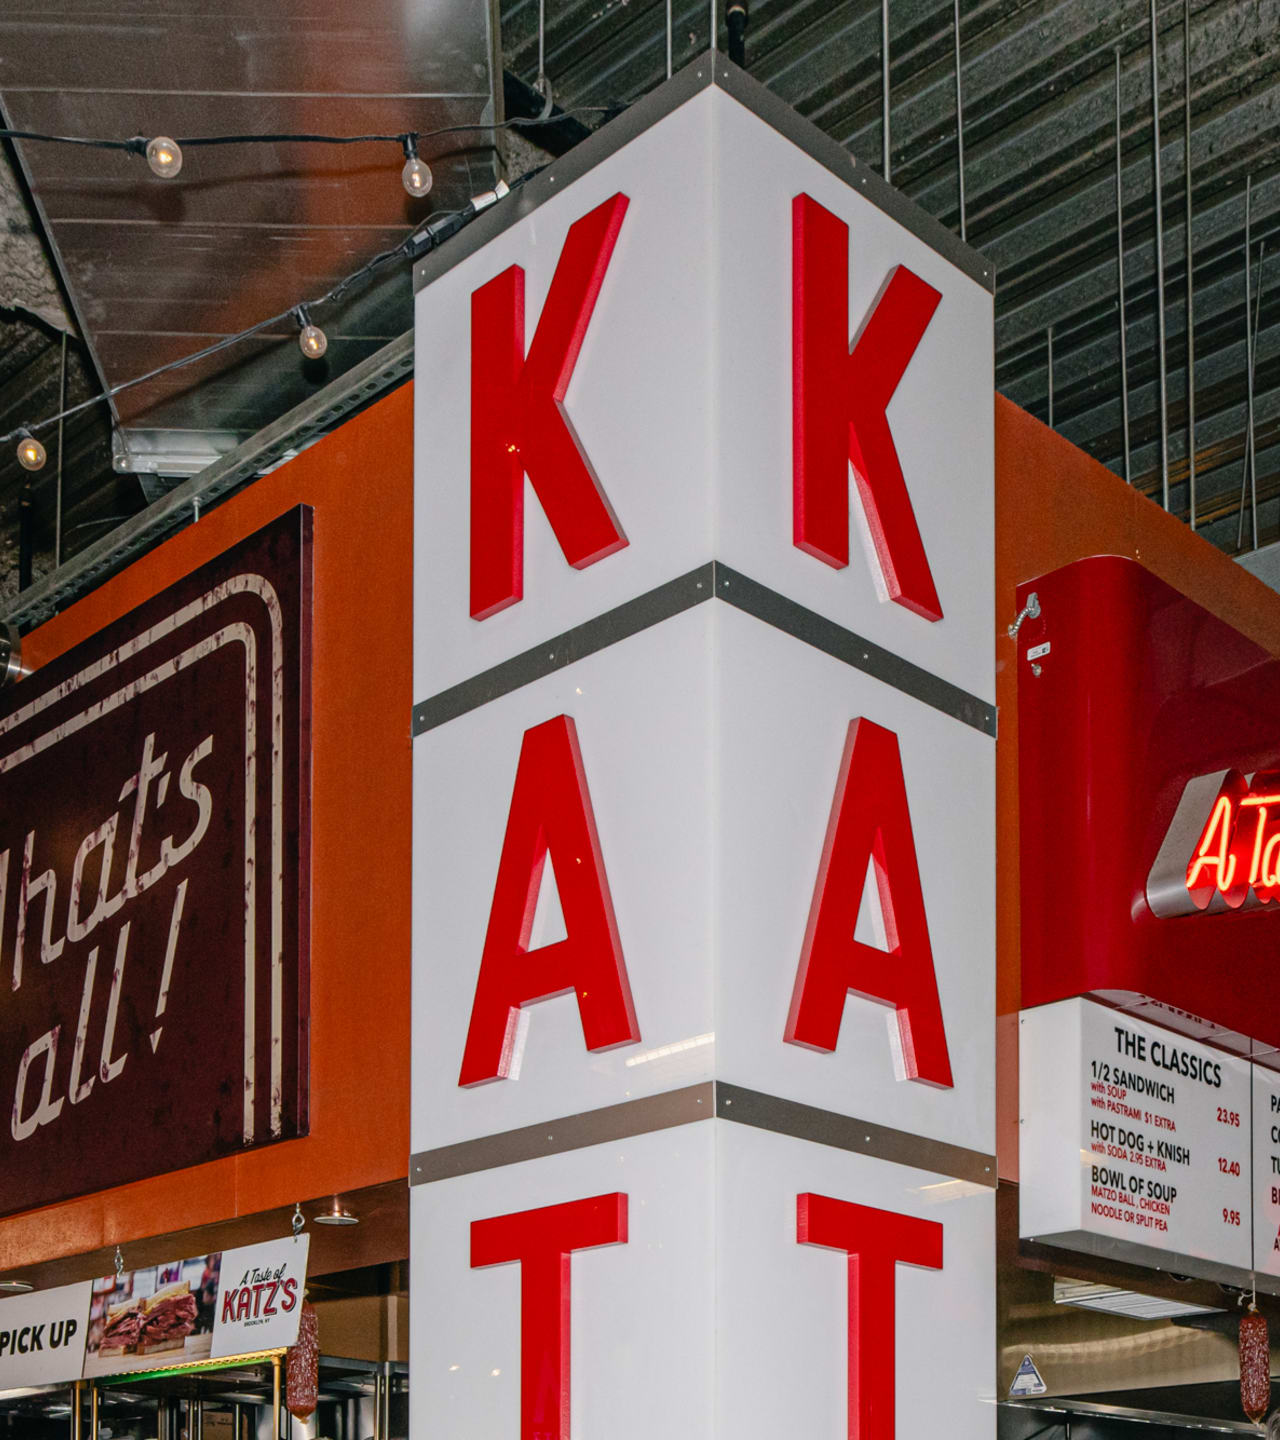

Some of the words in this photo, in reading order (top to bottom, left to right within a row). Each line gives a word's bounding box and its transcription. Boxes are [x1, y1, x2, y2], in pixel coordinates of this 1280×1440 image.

[1185, 785, 1242, 900] A
[11, 878, 187, 1141] all!
[1114, 1027, 1146, 1061] THE
[1150, 1042, 1221, 1088] CLASSICS
[1091, 1082, 1105, 1094] with
[1107, 1085, 1127, 1100] SOUP
[1091, 1061, 1110, 1082] 1/2
[1113, 1068, 1174, 1104] SANDWICH
[1217, 1107, 1240, 1127] 23.95
[1091, 1097, 1105, 1109] with
[1107, 1101, 1142, 1121] PASTRAMI
[1144, 1112, 1153, 1124] $1
[1154, 1115, 1176, 1131] EXTRA
[1091, 1120, 1115, 1143] HOT
[1118, 1128, 1144, 1152] DOG
[1157, 1140, 1190, 1166] KNISH
[1218, 1157, 1240, 1176] 12.40
[1091, 1143, 1105, 1155] with
[1107, 1145, 1127, 1160] SODA
[1130, 1151, 1144, 1165] 2.95
[1145, 1157, 1167, 1172] EXTRA
[1091, 1185, 1117, 1201] MATZO
[1139, 1198, 1170, 1216] CHICKEN
[1092, 1165, 1126, 1190] BOWL
[1128, 1176, 1144, 1194] OF
[1147, 1180, 1177, 1203] SOUP
[1091, 1203, 1122, 1221] NOODLE
[1124, 1210, 1135, 1224] OR
[1136, 1214, 1154, 1228] SPLIT
[1154, 1219, 1168, 1232] PEA
[1222, 1208, 1241, 1226] 9.95
[240, 1270, 249, 1286] A
[250, 1267, 272, 1284] Taste
[273, 1263, 287, 1280] of
[222, 1277, 298, 1324] KATZ'S
[49, 1319, 77, 1349] UP
